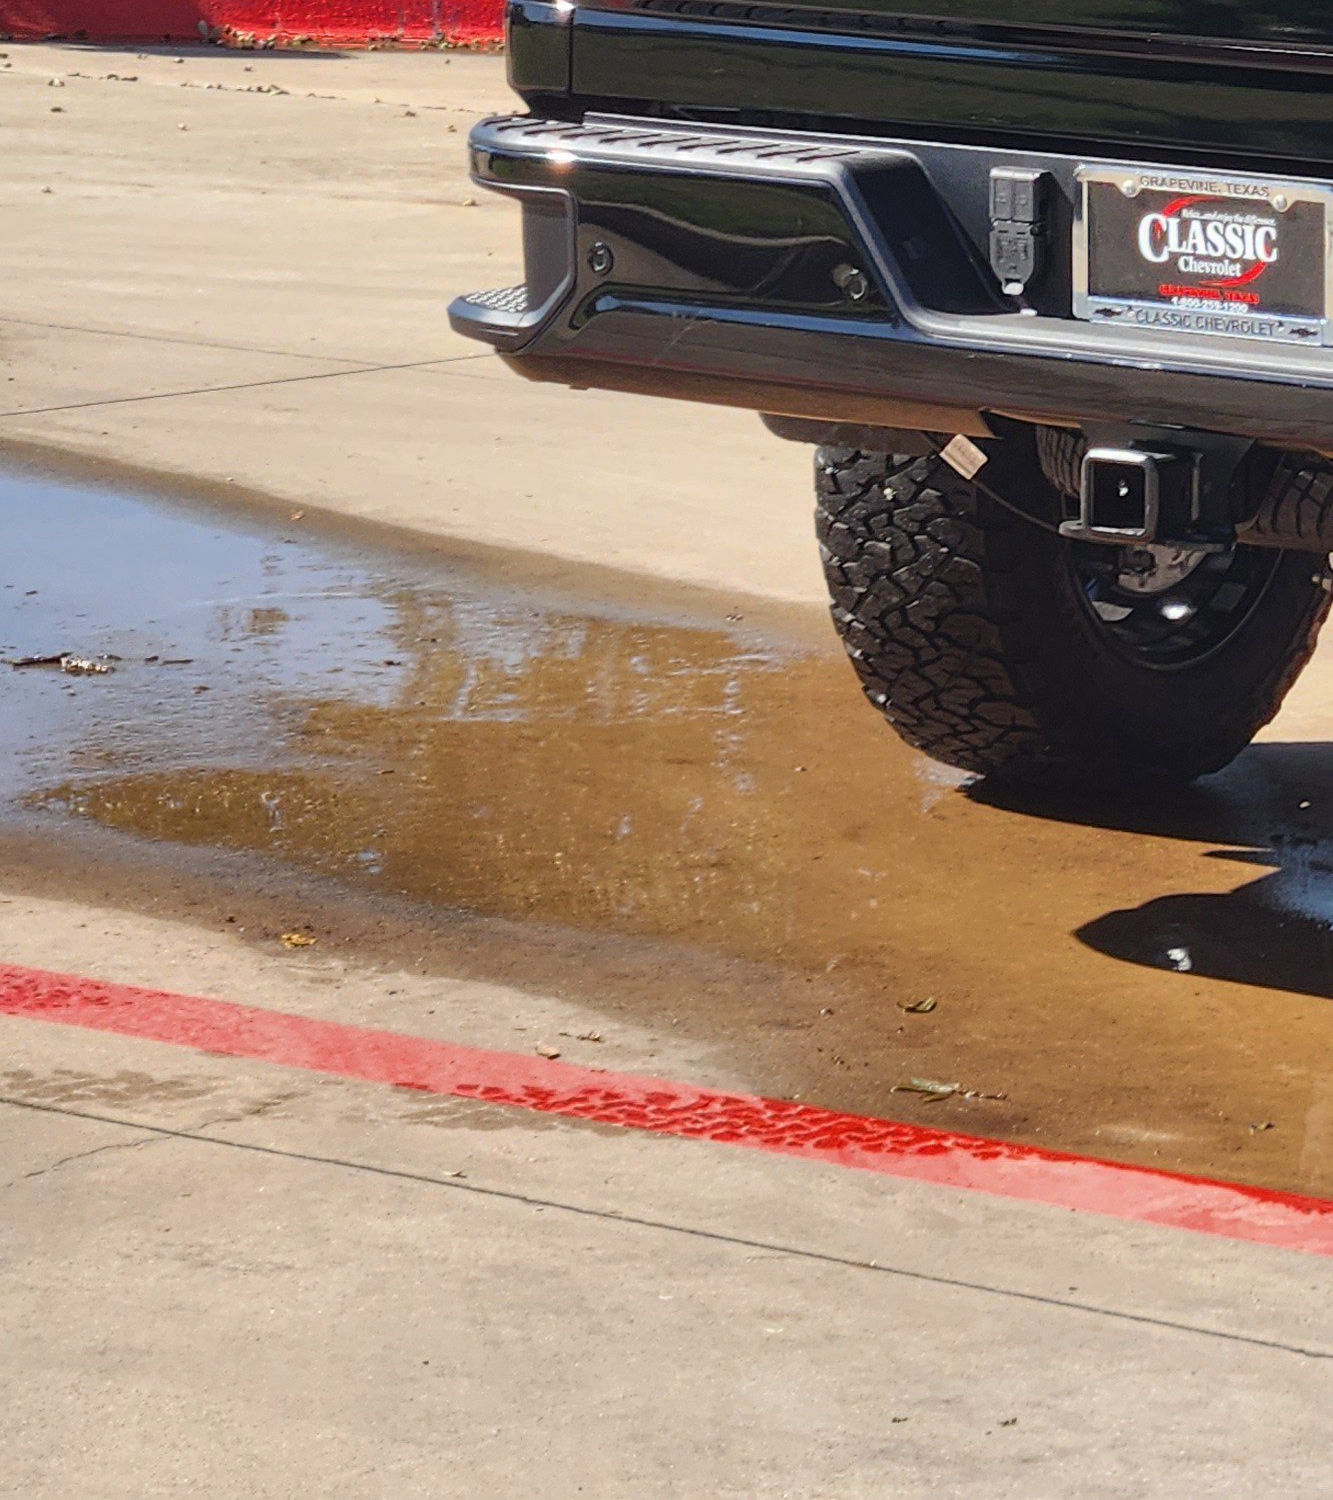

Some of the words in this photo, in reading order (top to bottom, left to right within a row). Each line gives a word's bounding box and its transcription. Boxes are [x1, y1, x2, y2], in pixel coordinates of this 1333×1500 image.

[1226, 182, 1270, 198] TEXAS
[1138, 213, 1278, 262] CLASSIC
[1178, 256, 1242, 277] Chevrolet
[1136, 309, 1191, 328] CLASSIC
[1195, 315, 1276, 336] CHEVROLET
